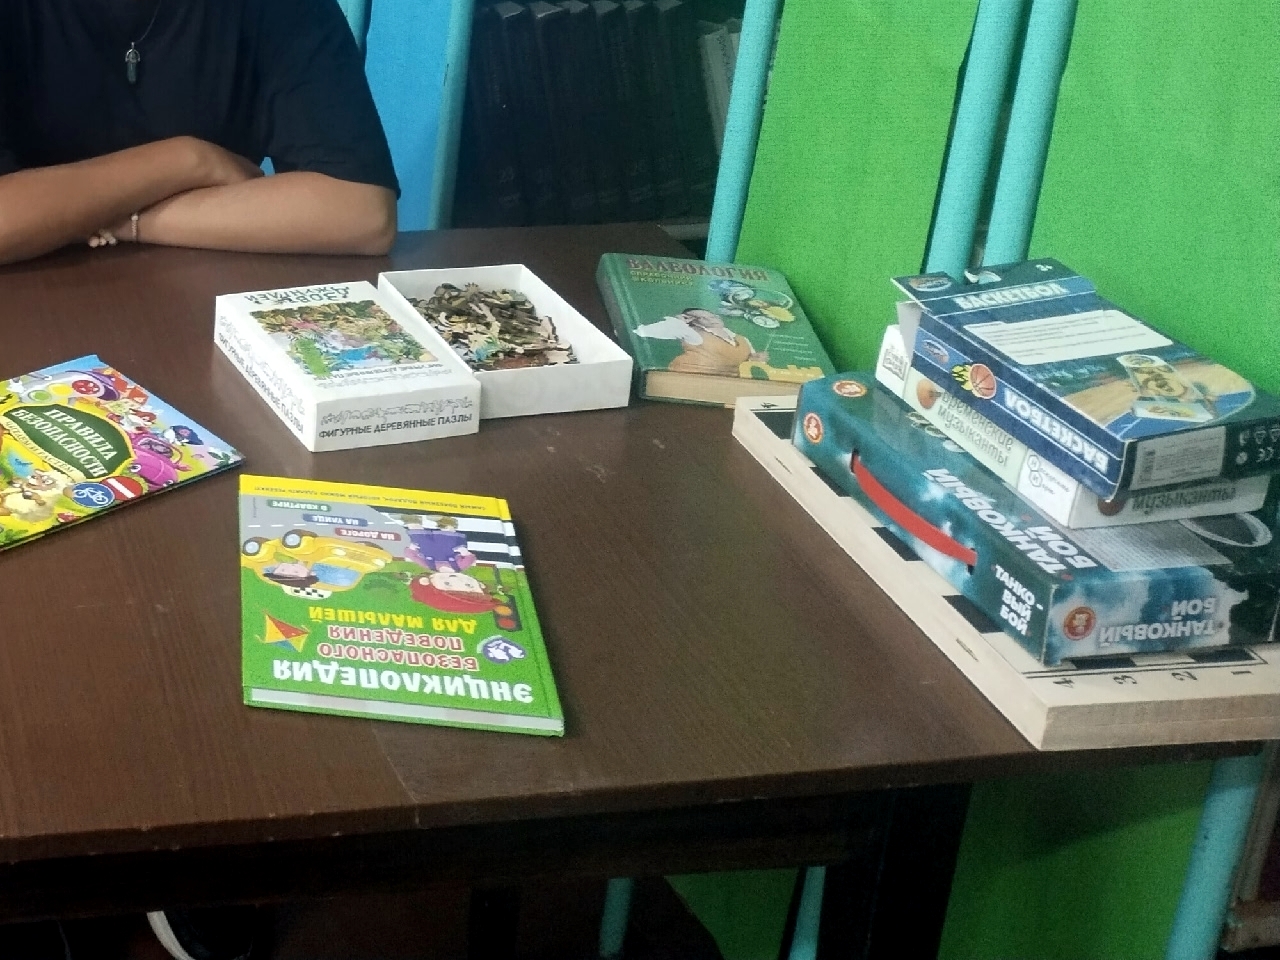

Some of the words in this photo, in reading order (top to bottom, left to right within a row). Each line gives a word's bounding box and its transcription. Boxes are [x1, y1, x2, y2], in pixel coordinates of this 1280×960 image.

[627, 258, 768, 282] ВАЛЕОЛОГИЯ
[953, 283, 1068, 310] БАСКЕТБОЛ
[42, 407, 118, 461] ПРАВИЛА
[318, 425, 372, 439] ФИГУРНЫЕ
[374, 417, 436, 433] ДЕРЕВЯННЫЕ
[437, 414, 472, 427] ПАЗЛЫ
[1004, 388, 1109, 474] БАСКЕТБОЛ
[11, 408, 108, 478] БЕЗОПАСНОСТИ
[272, 501, 320, 511] КВАРТИРЕ
[312, 515, 346, 526] УЛИЦЕ
[347, 517, 359, 526] НА
[922, 468, 1065, 575] ТАНКОВЫЙ
[340, 528, 380, 540] ДОРОГЕ
[381, 531, 395, 540] НА
[1030, 525, 1097, 569] БОЙ
[308, 606, 423, 628] МАЛЫШЕЙ
[1002, 589, 1032, 621] ВЫЙ
[1170, 597, 1216, 618] БОЙ
[432, 618, 477, 634] ДЛЯ
[1000, 604, 1028, 636] БОЙ
[1099, 619, 1218, 647] ТАНКОВЫЙ
[327, 625, 463, 651] ПОВЕДЕНИЯ
[316, 642, 479, 671] БЕЗОПАСНОГО
[273, 660, 533, 703] ЭНЦИКЛОПЕДИЯ
